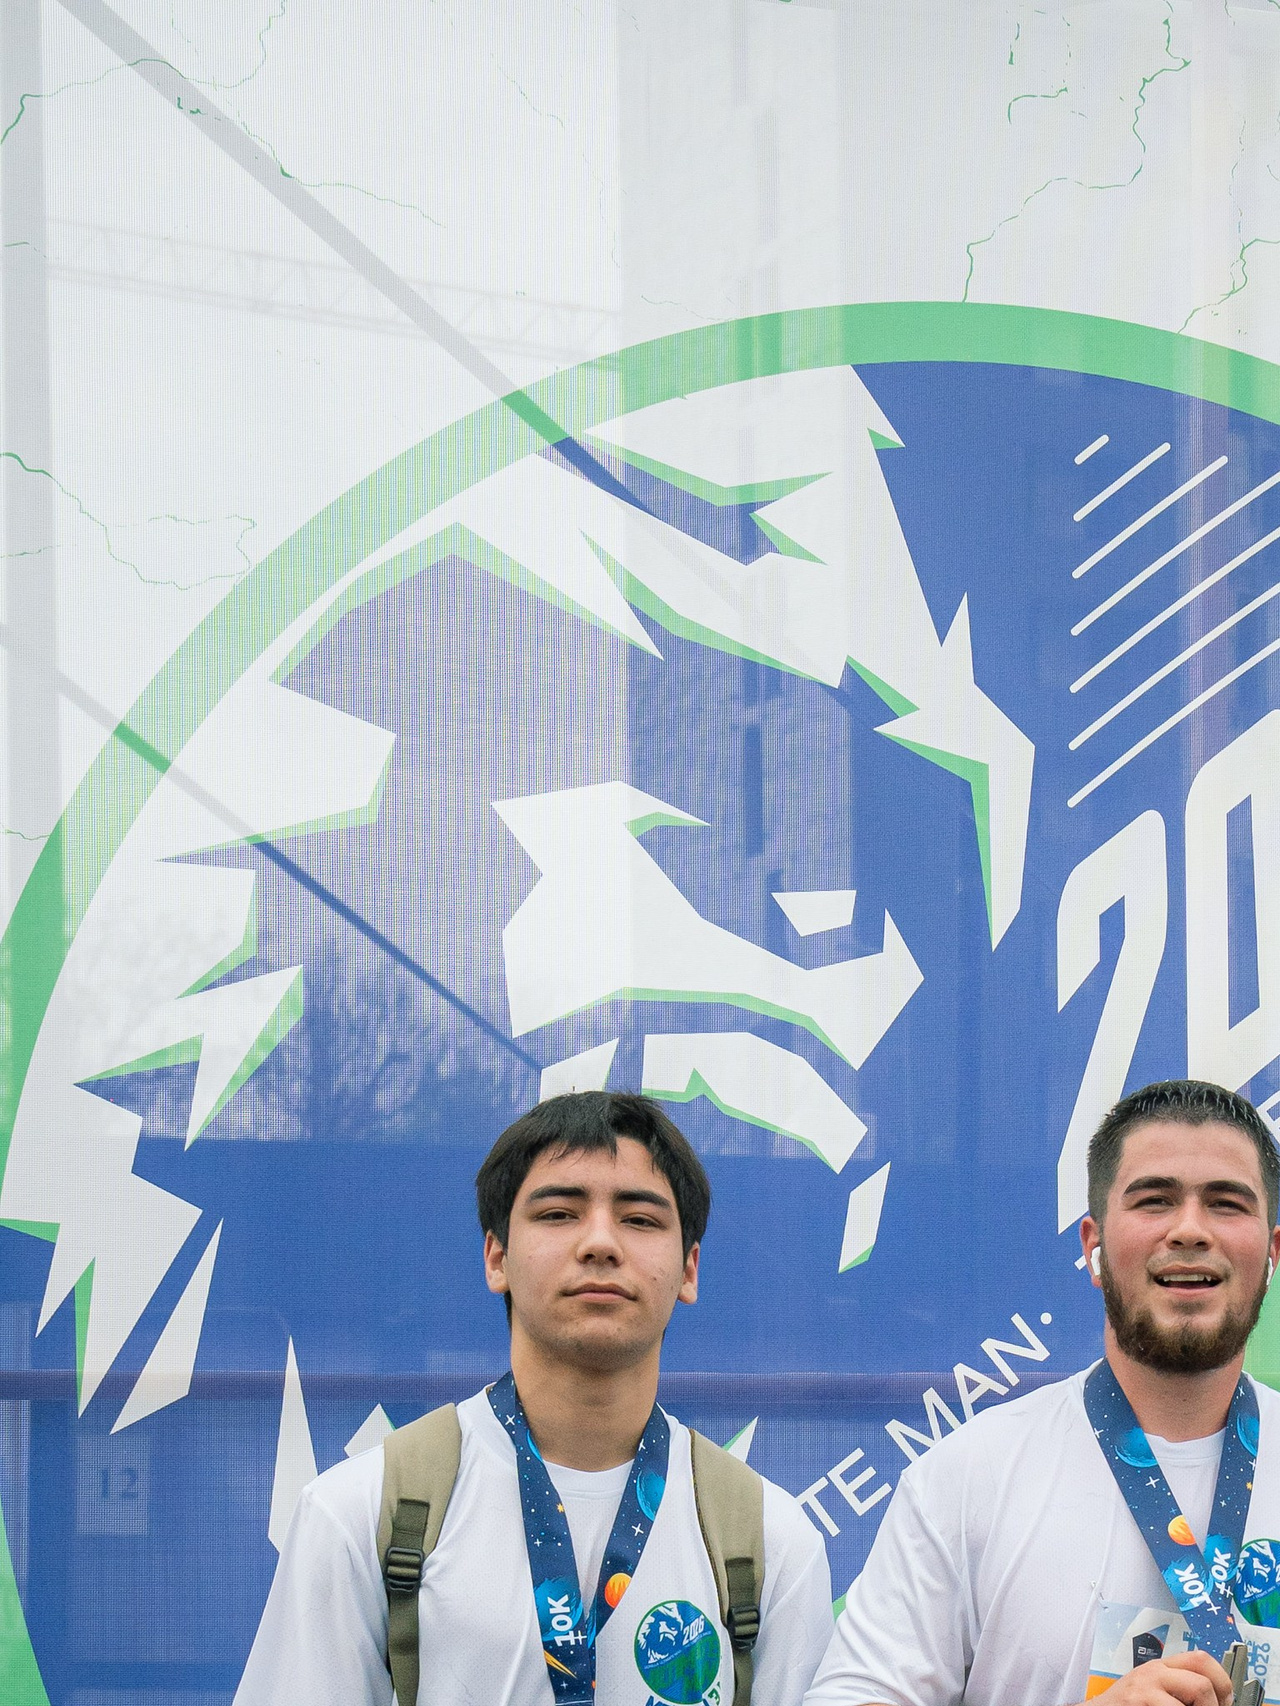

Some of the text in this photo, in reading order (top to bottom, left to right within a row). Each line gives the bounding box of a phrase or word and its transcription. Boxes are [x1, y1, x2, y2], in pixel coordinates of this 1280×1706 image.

[1174, 1562, 1212, 1608] 10K
[1211, 1547, 1232, 1595] 10K
[547, 1594, 576, 1648] 10K
[682, 1613, 706, 1647] 2026
